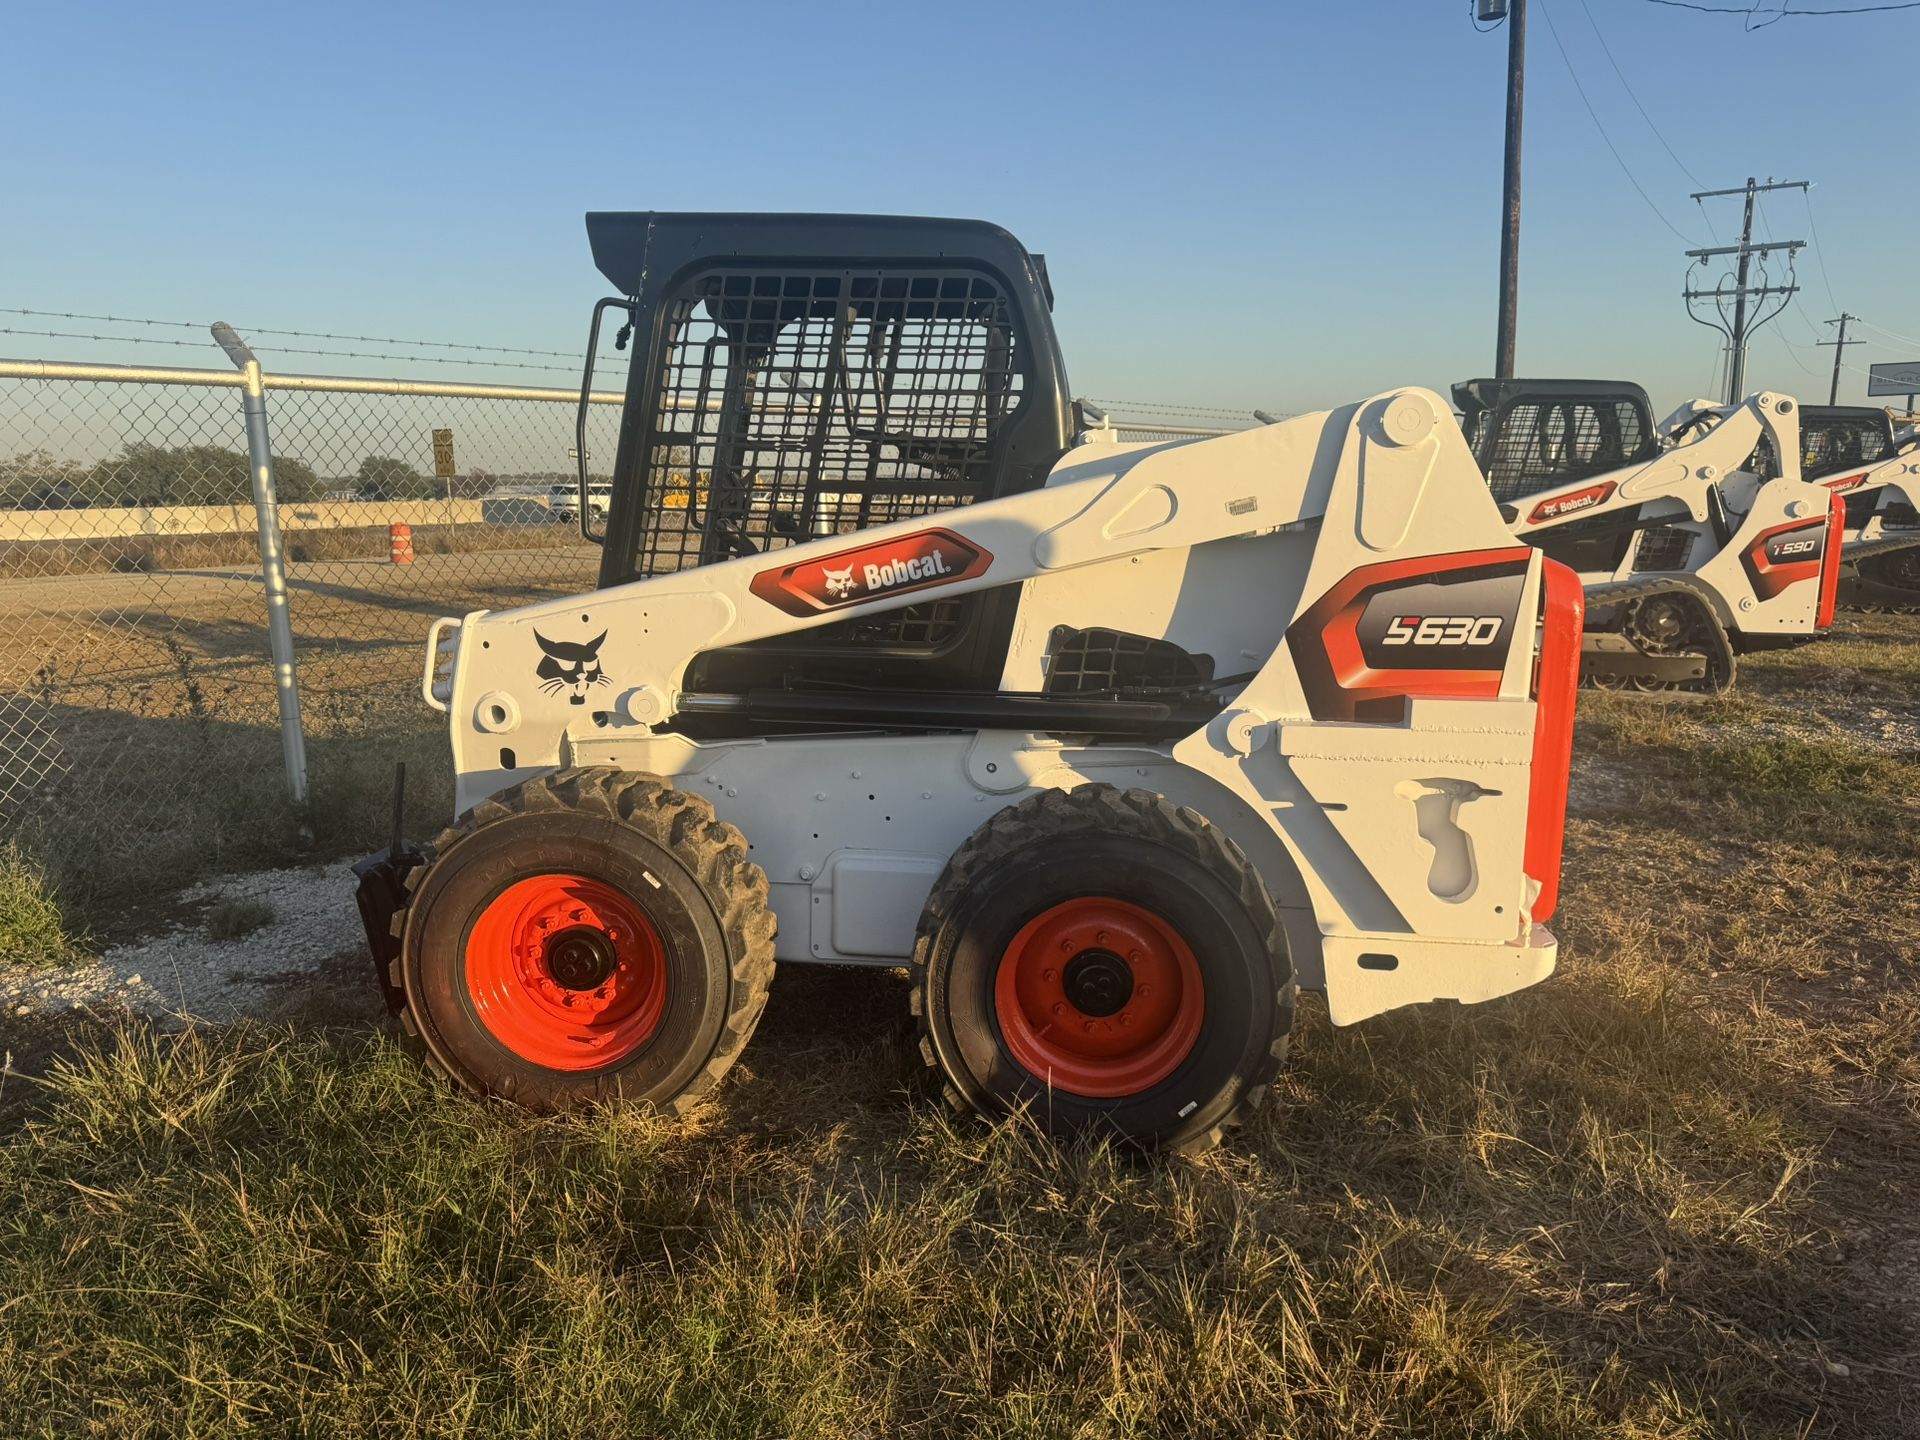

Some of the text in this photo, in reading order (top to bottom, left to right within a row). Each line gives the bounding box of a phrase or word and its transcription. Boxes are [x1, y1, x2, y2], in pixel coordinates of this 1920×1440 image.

[1559, 494, 1593, 513] Bobcat
[1773, 540, 1816, 556] T590
[863, 549, 947, 591] Bobcat
[1381, 616, 1504, 646] S630
